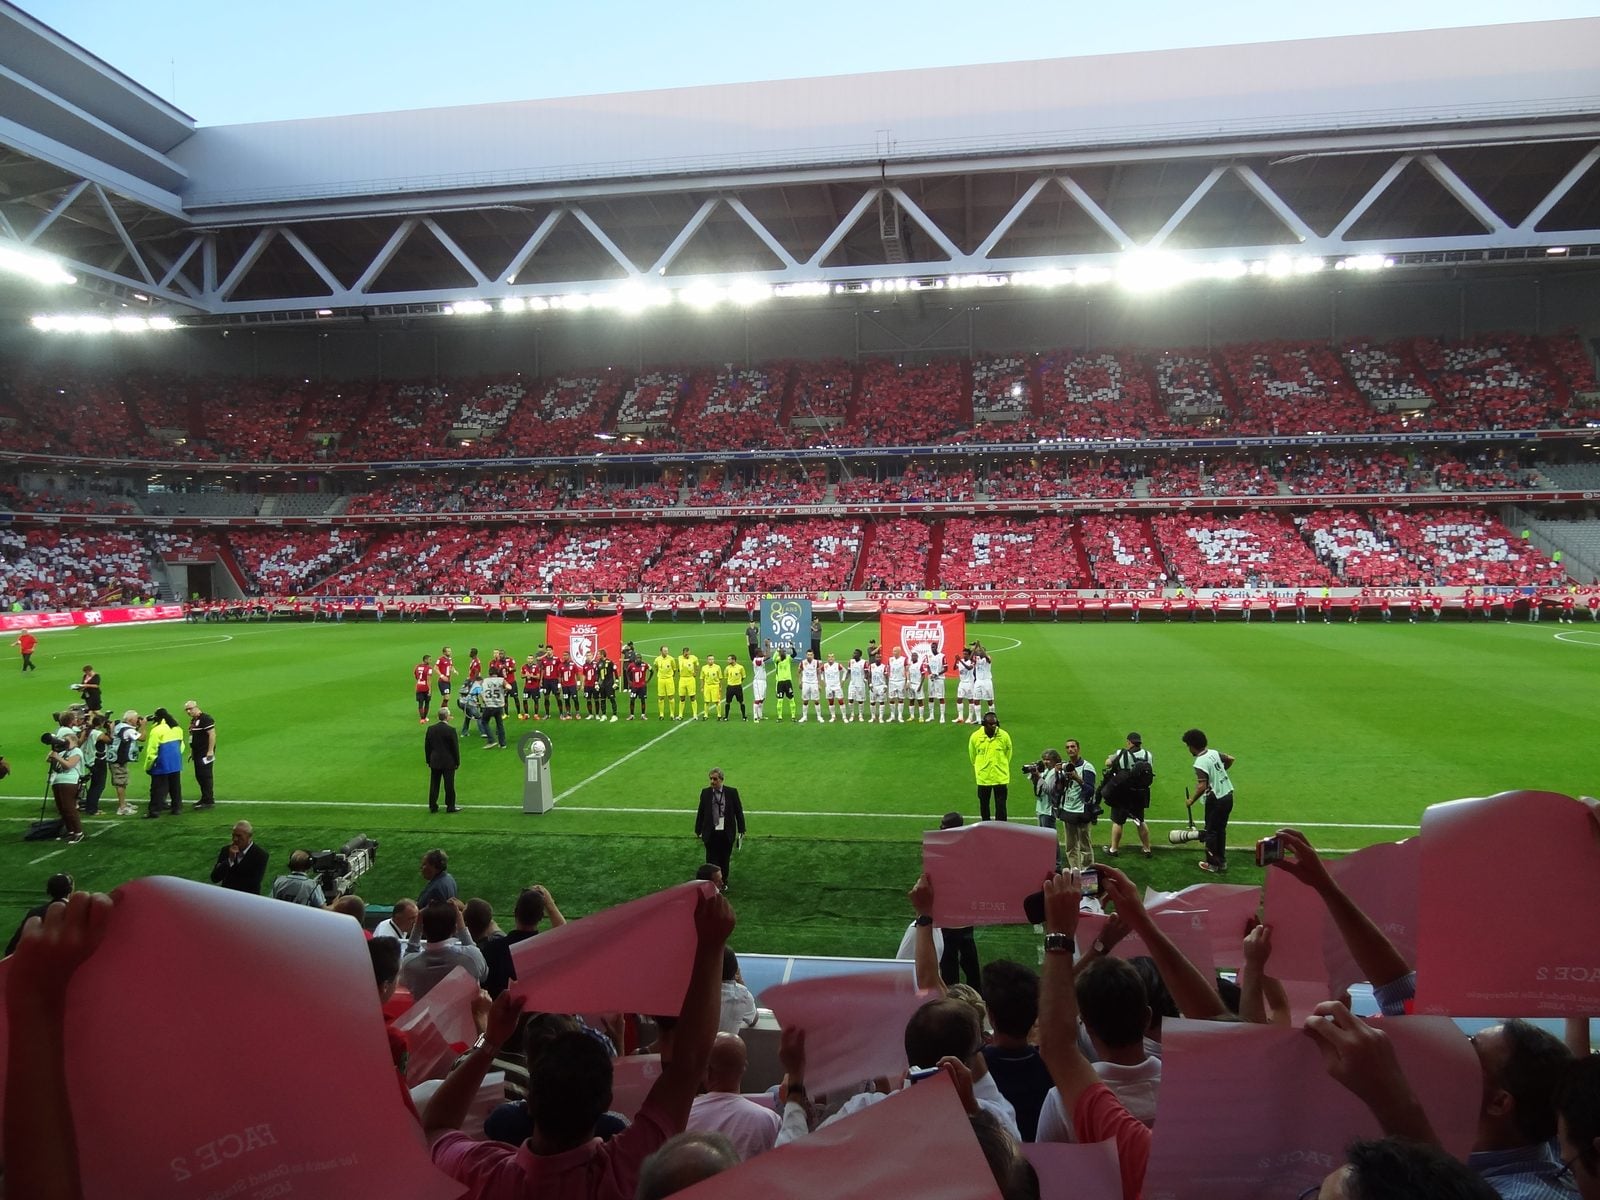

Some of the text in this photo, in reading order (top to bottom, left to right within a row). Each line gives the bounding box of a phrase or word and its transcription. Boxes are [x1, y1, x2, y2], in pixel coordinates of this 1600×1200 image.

[1212, 590, 1249, 598] Cédit
[1375, 589, 1414, 597] LOSC
[906, 629, 940, 639] ASNL
[485, 689, 500, 699] 35
